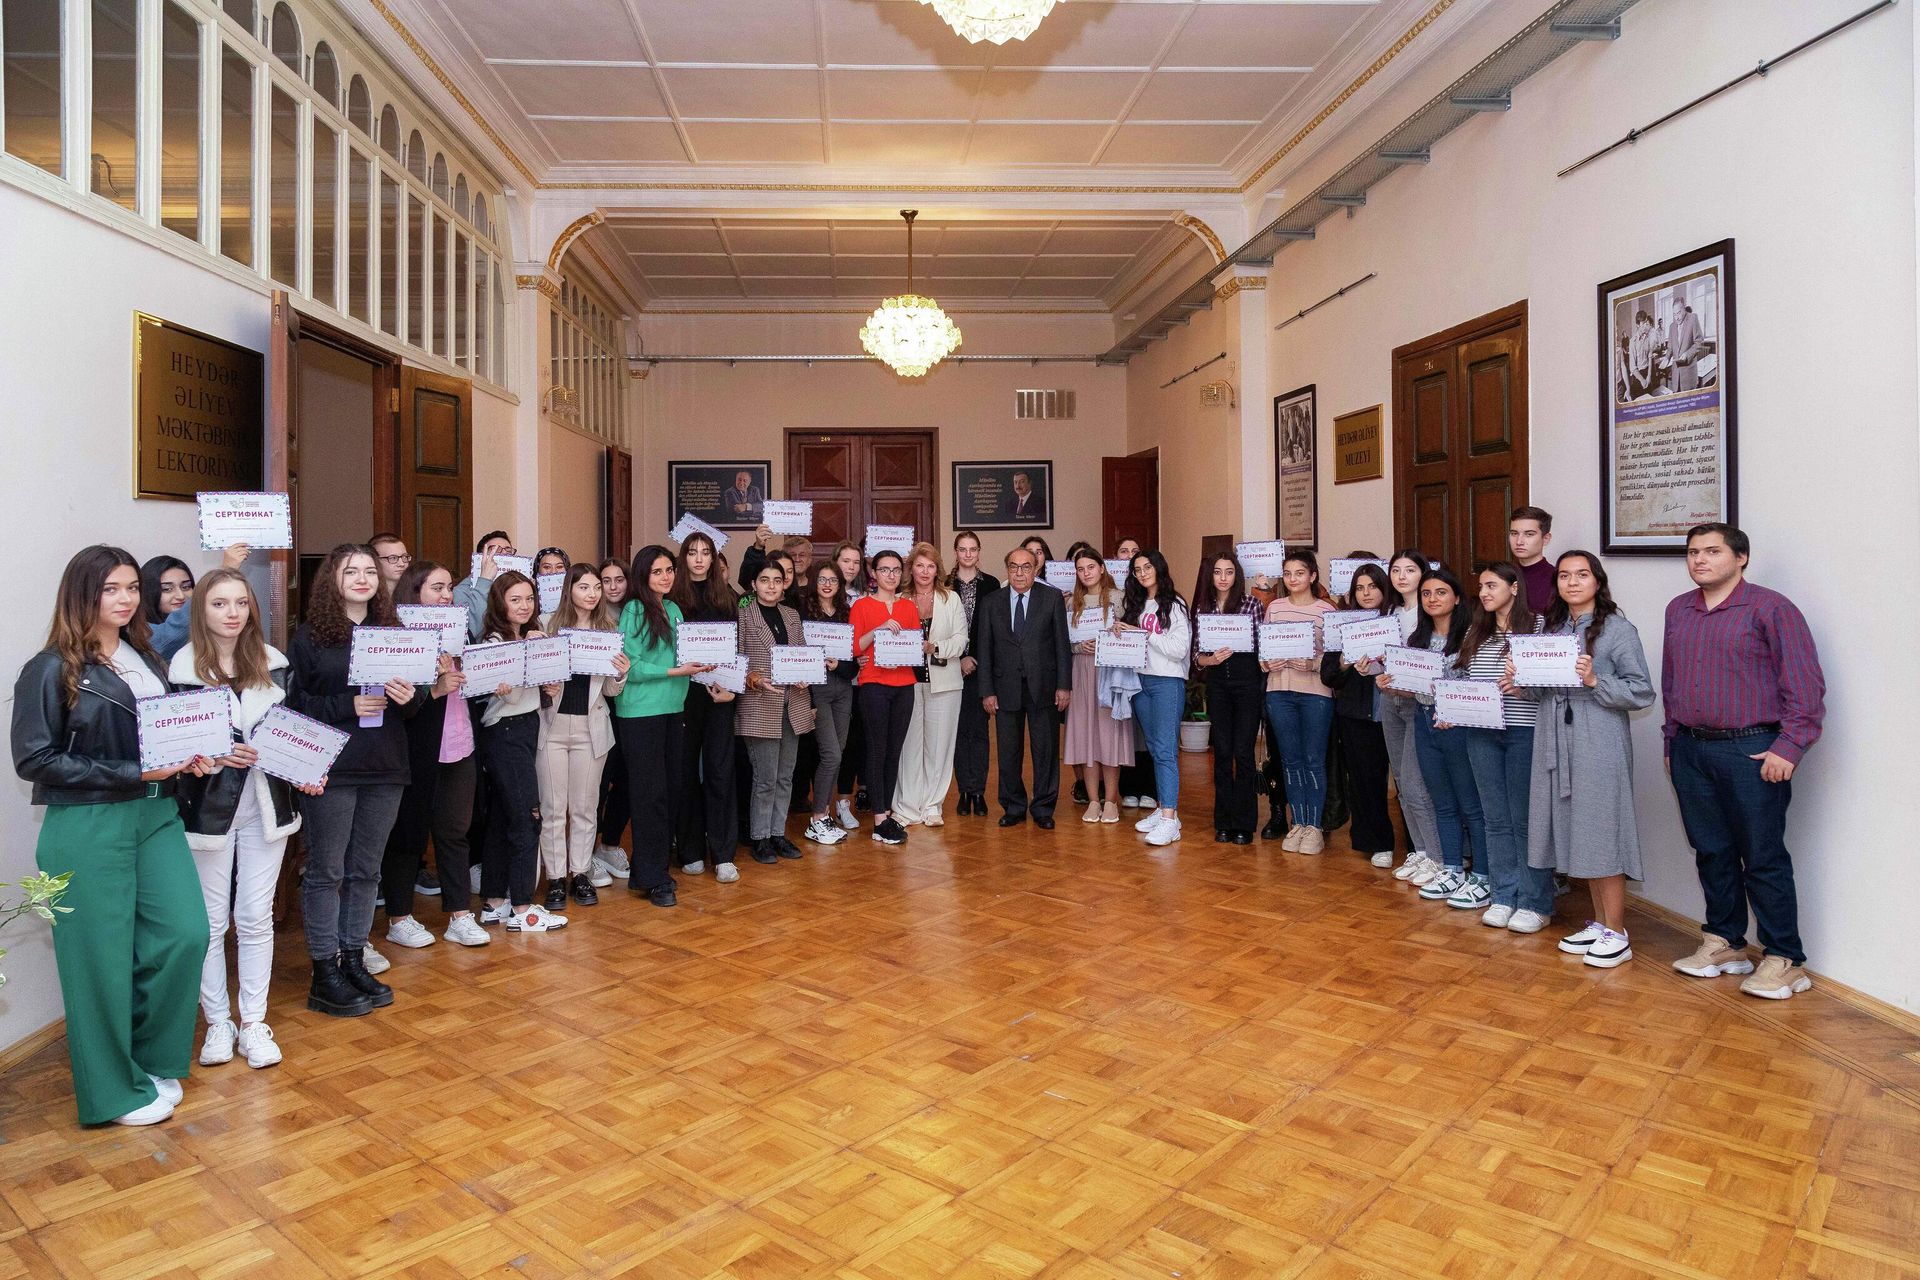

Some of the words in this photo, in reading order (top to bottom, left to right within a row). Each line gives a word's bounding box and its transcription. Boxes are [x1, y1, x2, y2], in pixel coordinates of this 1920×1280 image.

[171, 352, 239, 388] HEYDƏR
[175, 386, 237, 416] ƏLİYEV
[1655, 470, 1671, 478] sosial
[1674, 468, 1694, 476] sahədə
[215, 510, 274, 518] СЕРТИФИКАТ
[687, 635, 727, 643] СЕРТИФИКАТ
[810, 632, 845, 641] СЕРТИФИКАТ
[1350, 629, 1390, 640] СЕРТИФИКАТ
[367, 646, 426, 654] СЕРТИФИКАТ
[532, 651, 562, 660] СЕРТИФИКАТ
[473, 658, 515, 671] СЕРТИФИКАТ
[1394, 659, 1434, 671] СЕРТИФИКАТ
[1445, 693, 1490, 703] СЕРТИФИКАТ
[155, 711, 216, 729] СЕРТИФИКАТ
[271, 727, 325, 754] СЕРТИФИКАТ
